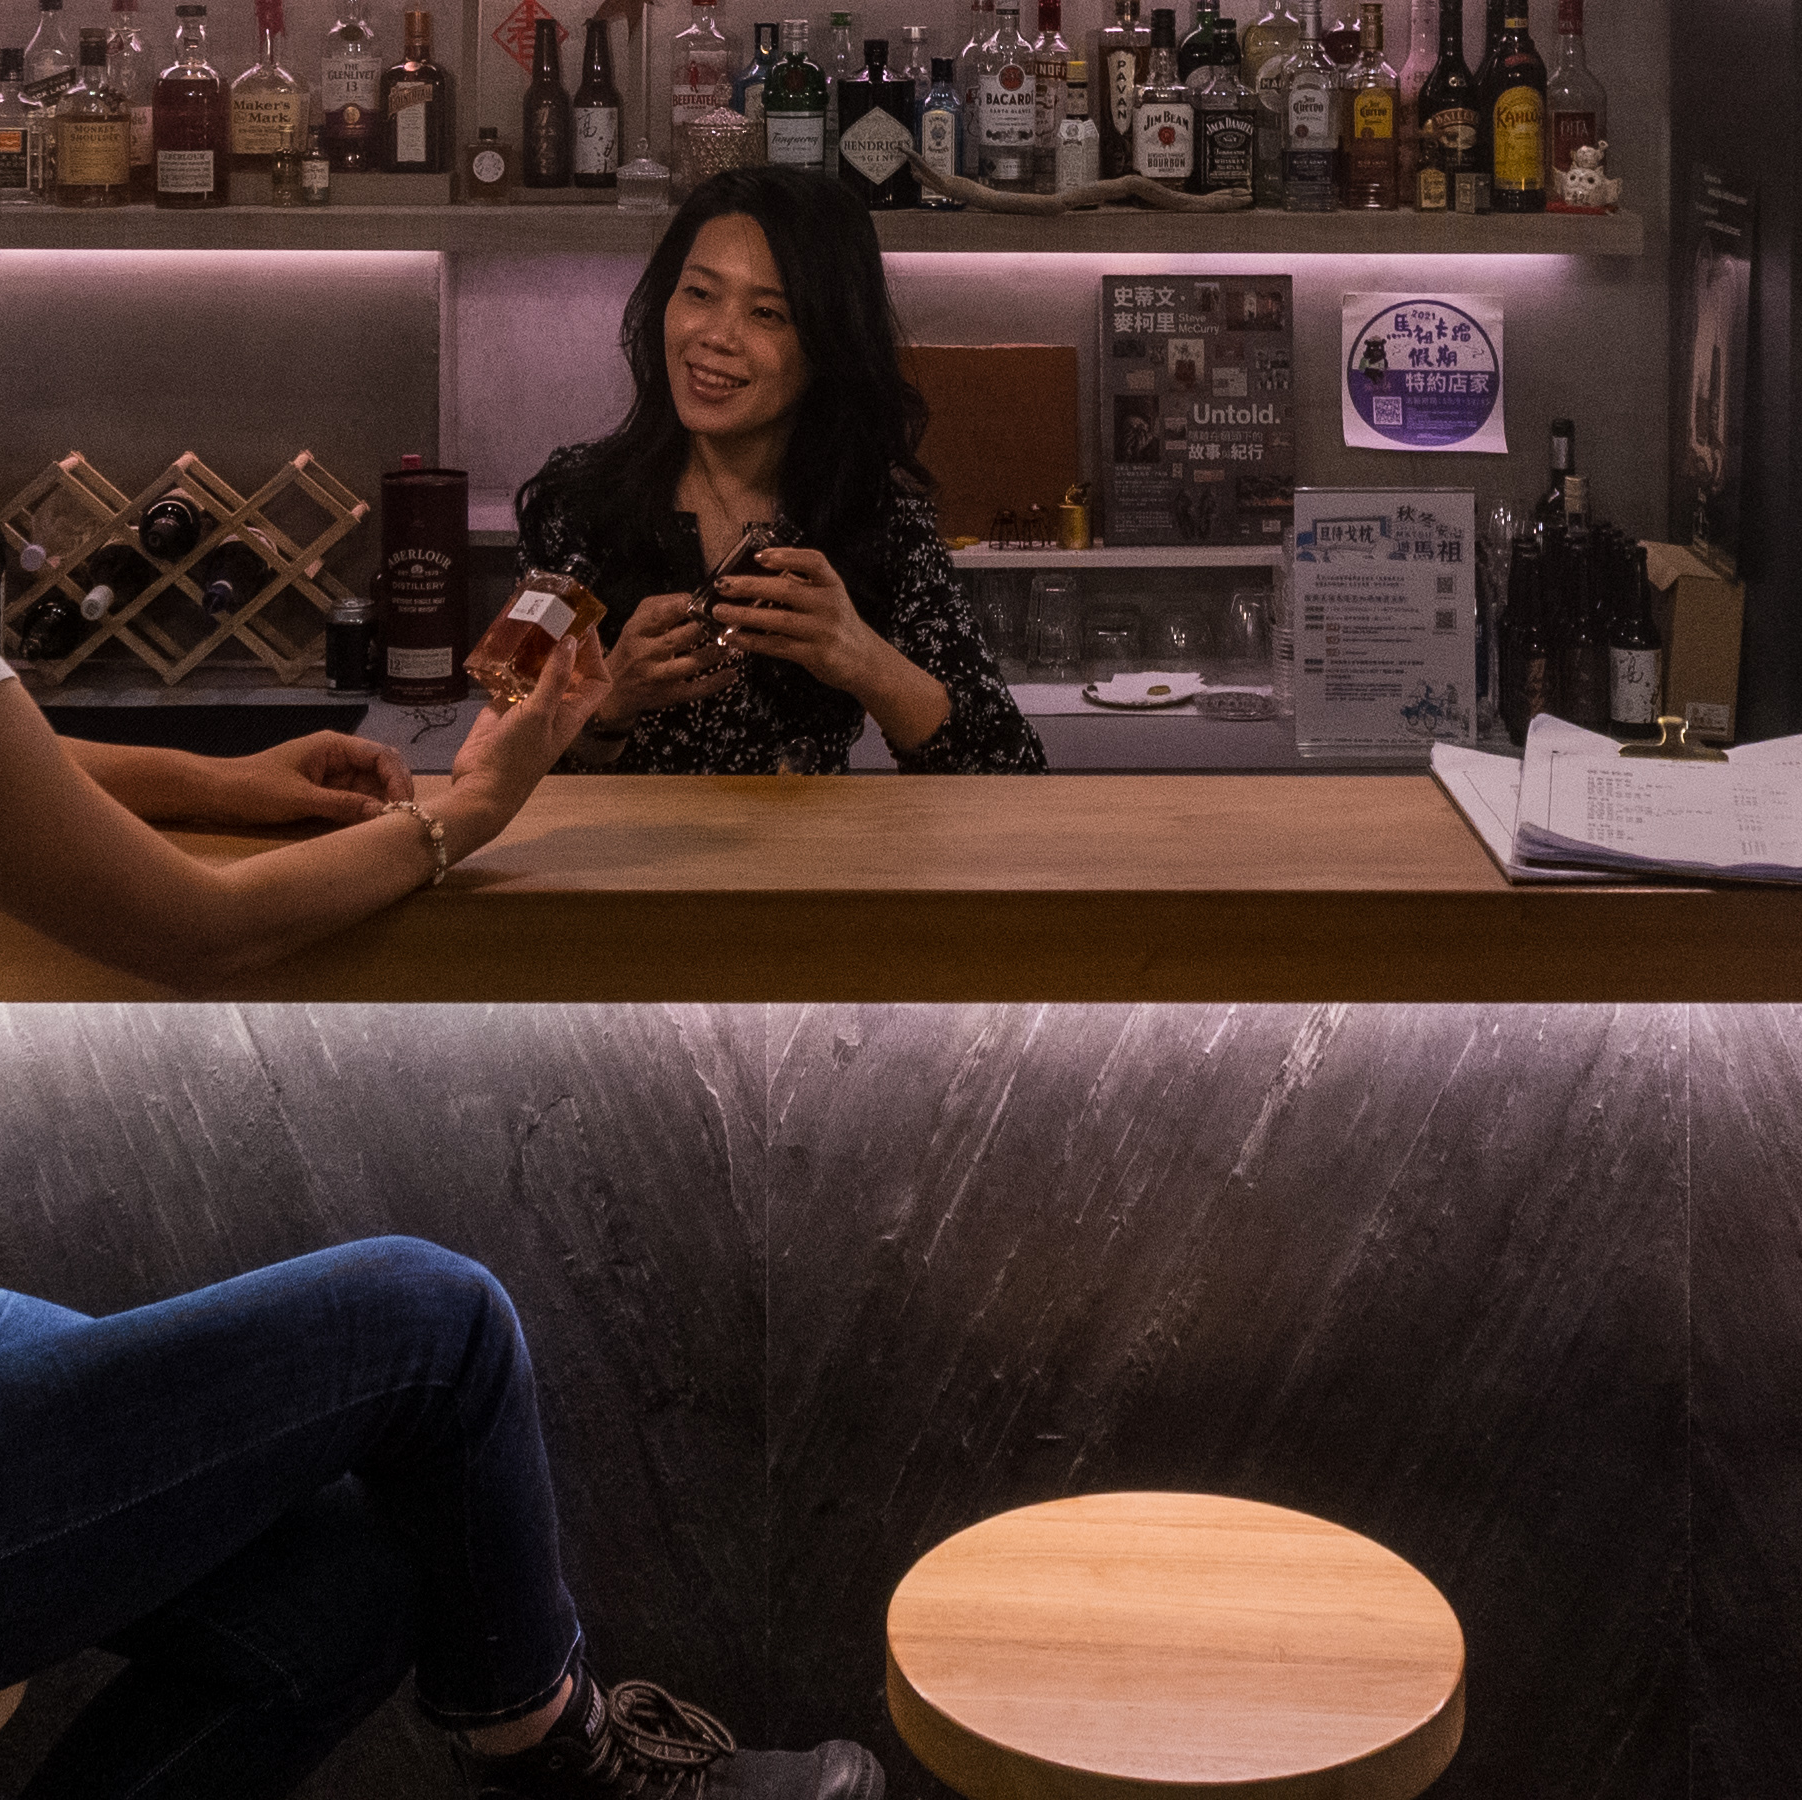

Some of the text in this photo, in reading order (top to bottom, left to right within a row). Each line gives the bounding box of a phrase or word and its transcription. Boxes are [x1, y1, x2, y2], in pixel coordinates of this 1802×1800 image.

[328, 70, 375, 80] GLENLIVET
[346, 81, 358, 92] 13
[1117, 60, 1128, 119] PAVAN
[233, 100, 291, 111] Maker's
[1293, 101, 1323, 114] Cuervo
[248, 111, 289, 123] Mark
[1360, 107, 1387, 118] Cuervo
[1143, 110, 1189, 131] JIM BEAM
[772, 131, 819, 146] Tanqueray
[1148, 158, 1185, 167] BOURBON
[1178, 313, 1207, 323] Steve
[1411, 310, 1436, 321] 2021
[1114, 311, 1176, 333] 麥柯里
[1178, 324, 1220, 335] McCurry
[1409, 345, 1458, 367] 假期
[1405, 373, 1490, 394] 特約店家
[1193, 403, 1281, 425] Untold.
[388, 549, 452, 570] ABERLOUR
[392, 582, 445, 591] DISTILLERY
